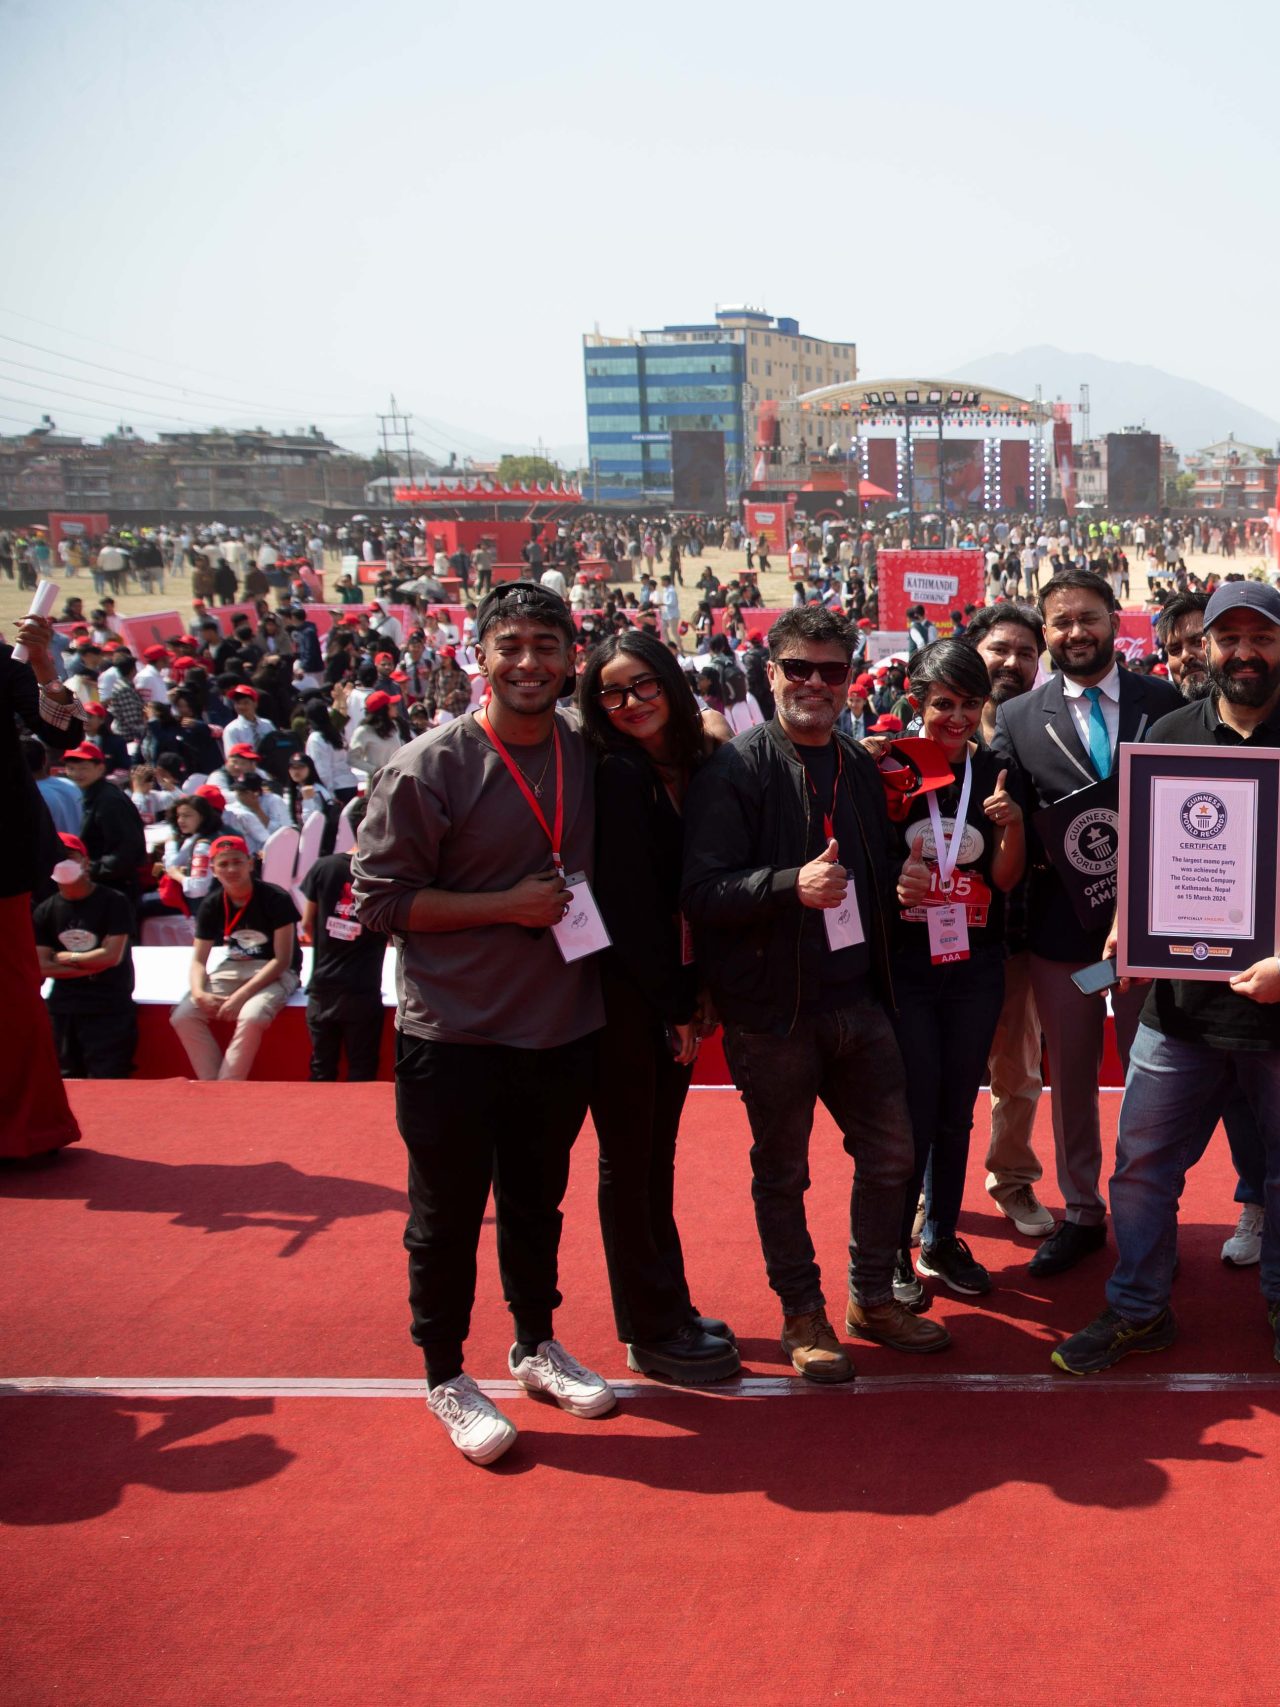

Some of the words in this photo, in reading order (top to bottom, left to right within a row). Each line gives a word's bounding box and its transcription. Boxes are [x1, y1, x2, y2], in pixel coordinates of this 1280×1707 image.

[906, 577, 955, 592] KATHMANDU
[1187, 795, 1222, 809] GUINNESS
[1069, 812, 1114, 841] GUINNESS
[1182, 812, 1199, 836] WORLD
[1199, 813, 1225, 838] RECORDS
[1179, 842, 1227, 850] CERTIFICATE
[1071, 849, 1102, 871] WORLD
[1183, 857, 1202, 865] largest
[1181, 875, 1210, 883] Coca-Cola
[1210, 877, 1236, 885] Company
[941, 953, 961, 962] AAA
